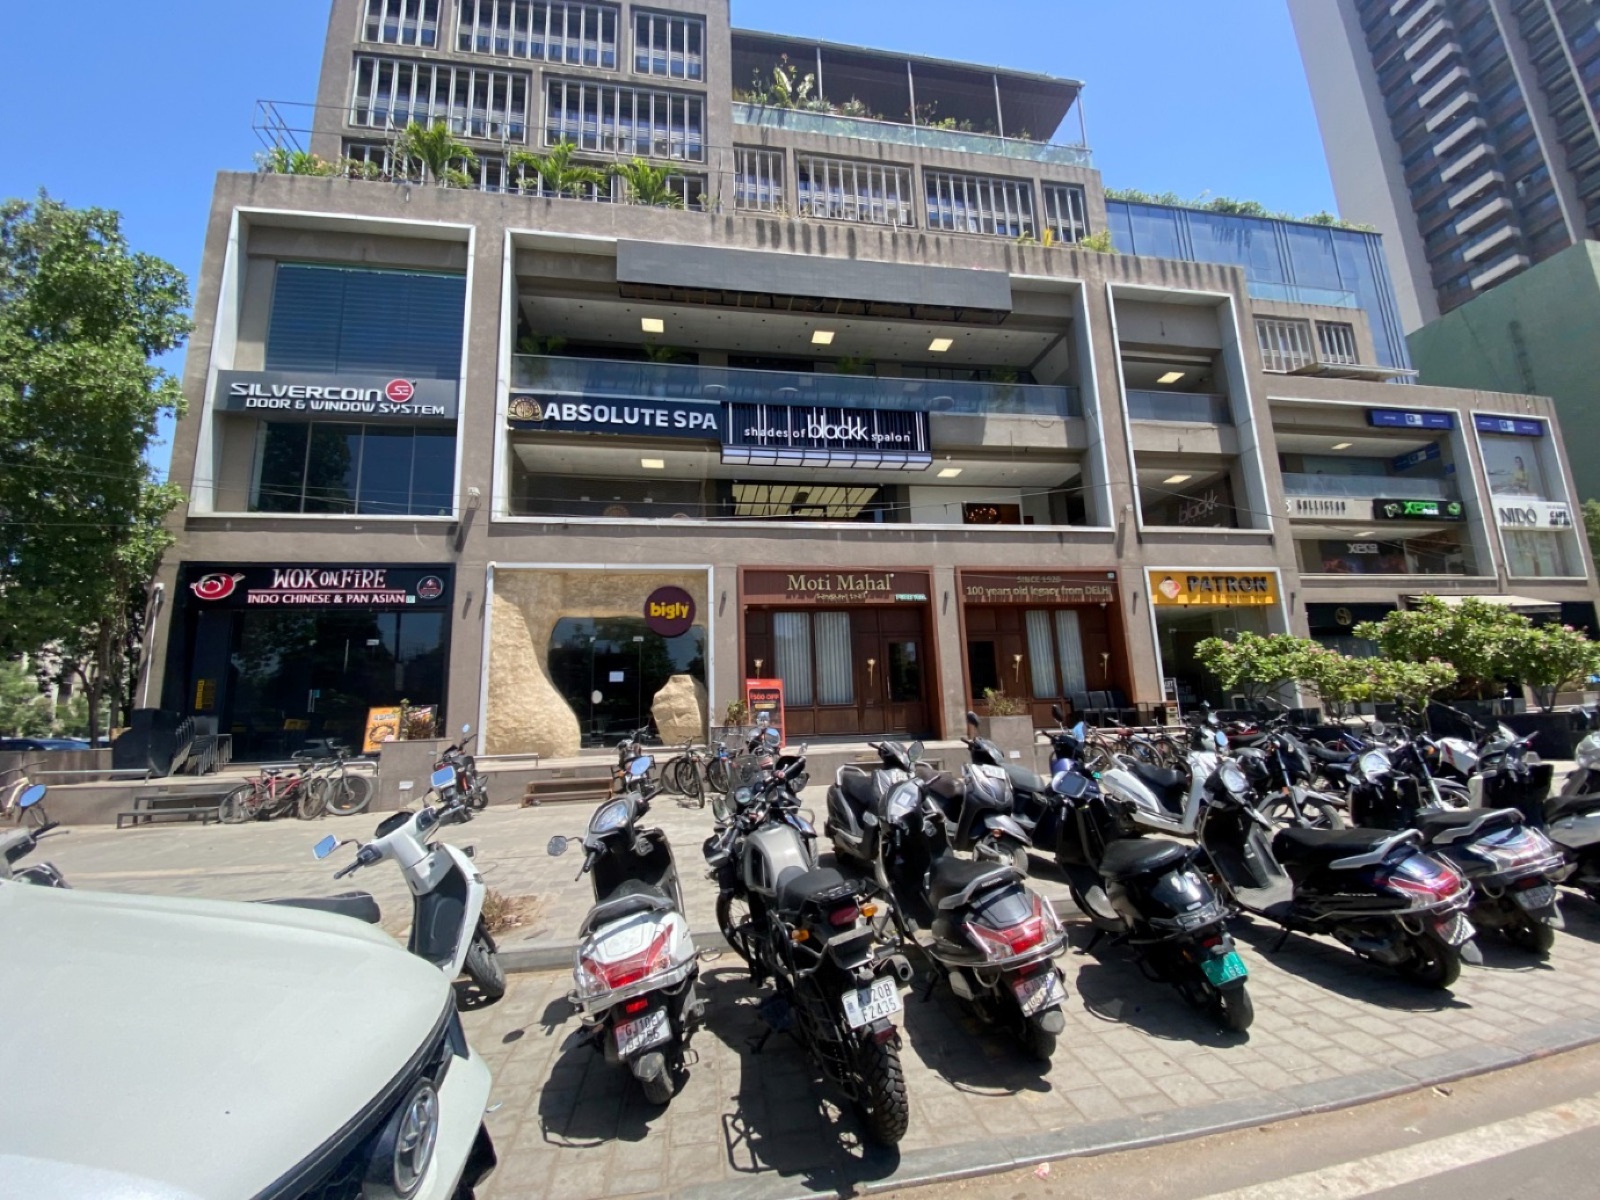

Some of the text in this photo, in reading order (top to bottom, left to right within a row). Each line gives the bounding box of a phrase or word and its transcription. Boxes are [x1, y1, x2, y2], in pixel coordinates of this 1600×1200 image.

[230, 382, 383, 401] SILVERCOIN
[246, 398, 291, 410] DOOR
[310, 400, 376, 412] WINDOW
[379, 402, 445, 415] SYSTEM
[544, 402, 669, 427] ABSOLUTE
[674, 410, 718, 430] SPA
[744, 426, 788, 438] shades
[793, 428, 806, 438] of
[807, 414, 868, 440] blackk
[270, 568, 320, 589] WOK
[787, 573, 892, 591] Moti Mahal
[1186, 575, 1268, 593] PATRON
[248, 594, 279, 604] INDO
[282, 594, 331, 604] CHINESE
[333, 594, 343, 604] &
[346, 594, 369, 604] PAN
[371, 594, 405, 604] ASIAN
[967, 586, 1111, 597] 100 years old legacy from DELHI
[650, 601, 690, 620] bigly
[857, 983, 892, 1006] RJ20B
[861, 997, 896, 1022] F2435
